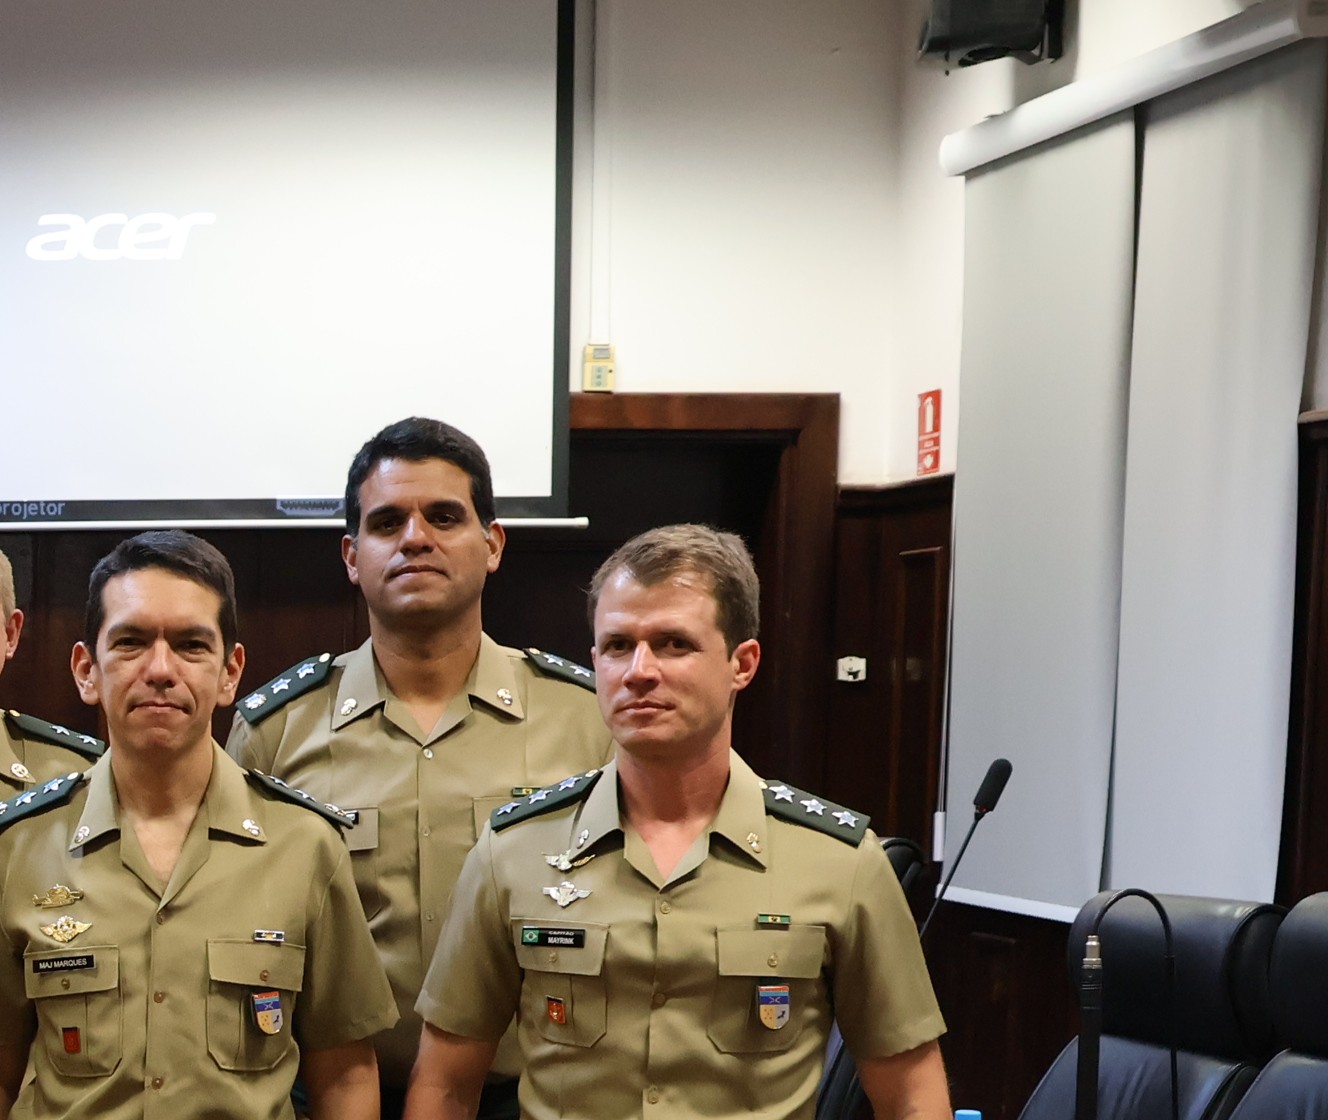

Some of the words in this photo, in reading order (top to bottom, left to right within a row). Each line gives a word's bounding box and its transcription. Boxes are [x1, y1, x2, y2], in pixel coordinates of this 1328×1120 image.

[25, 212, 217, 261] acer
[39, 961, 53, 970] MAJ
[53, 957, 88, 968] MARQUES
